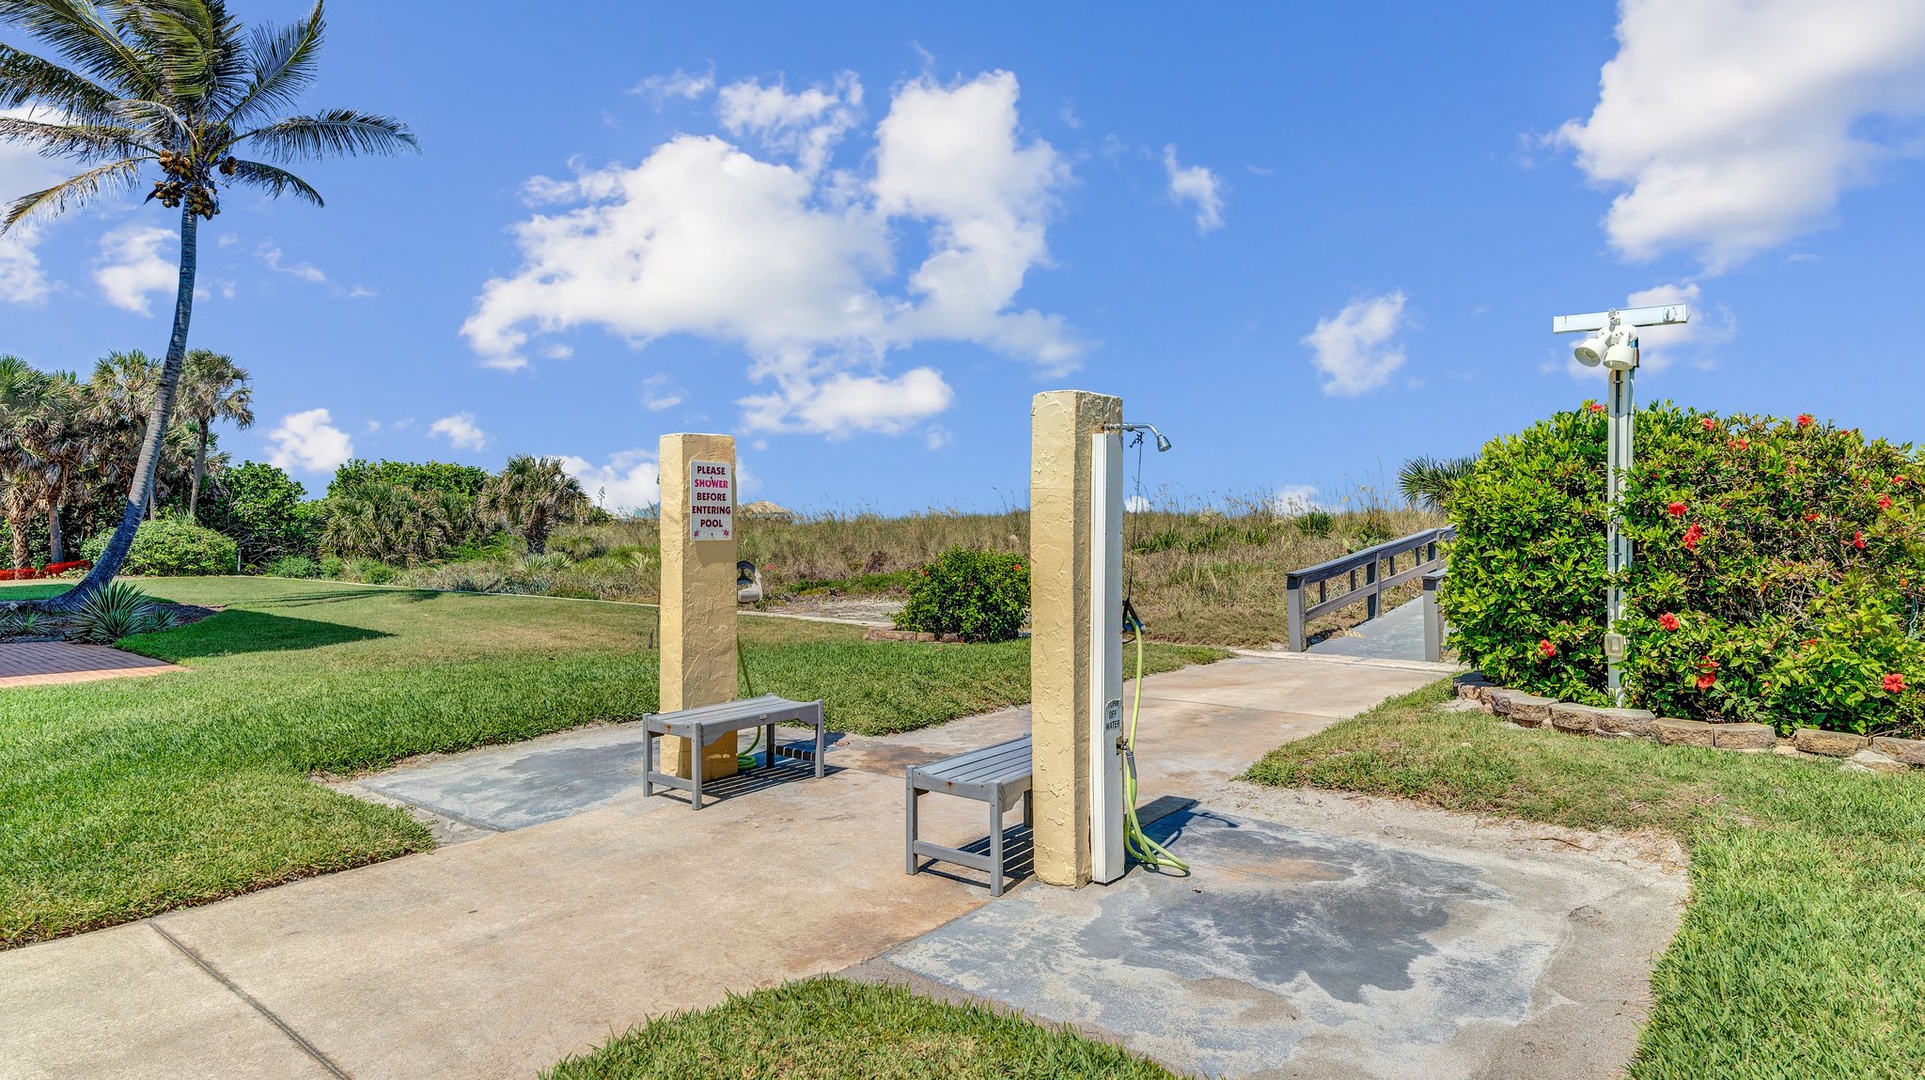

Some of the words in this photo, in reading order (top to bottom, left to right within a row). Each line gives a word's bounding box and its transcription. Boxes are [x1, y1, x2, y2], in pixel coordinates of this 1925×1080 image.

[697, 466, 726, 475] PLEASE
[694, 479, 728, 488] SHOWER
[697, 493, 726, 501] BEFORE
[692, 506, 731, 514] ENTERING
[700, 519, 723, 527] POOL
[1108, 710, 1117, 719] OFF
[1105, 720, 1120, 730] WATER
